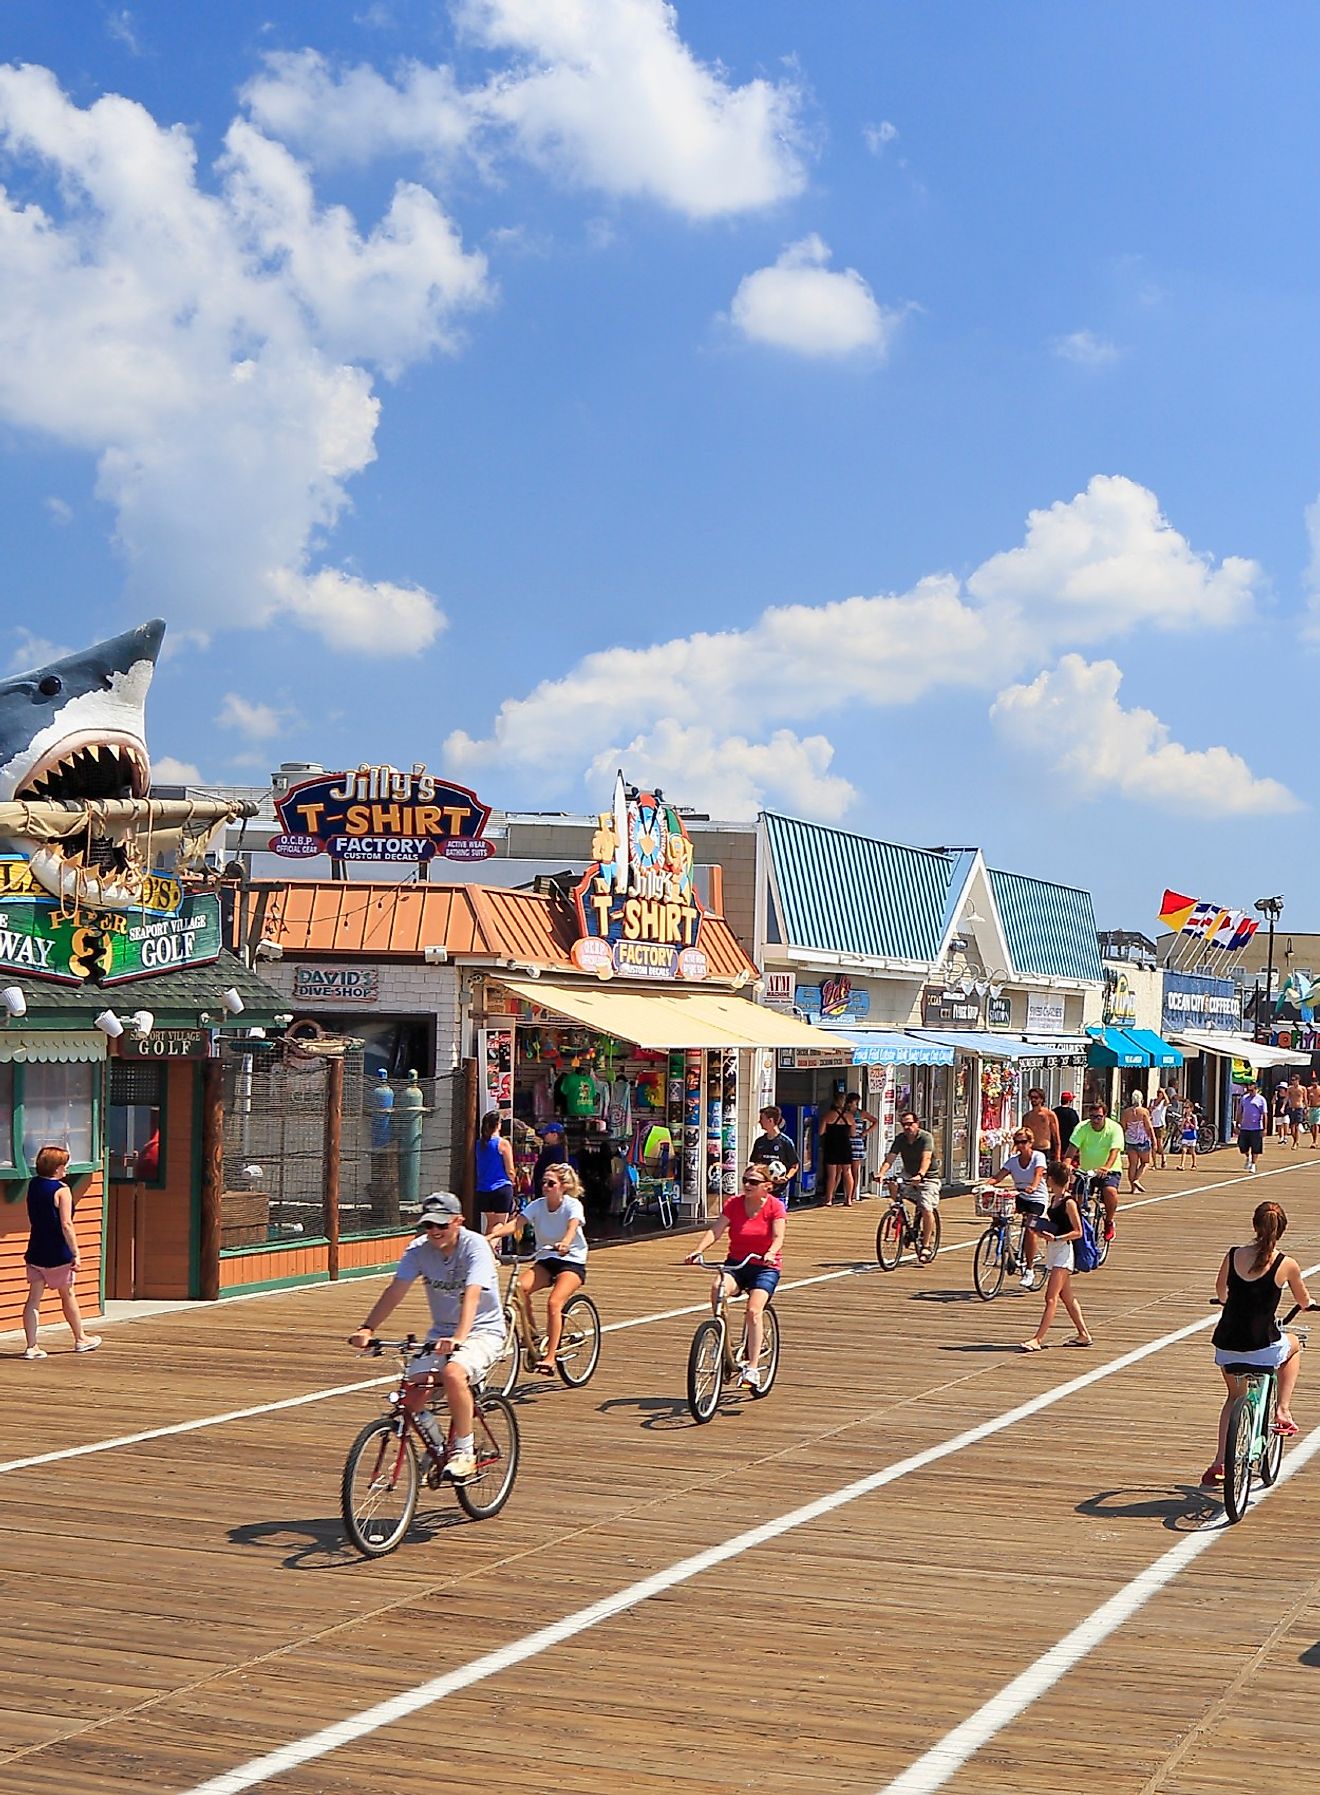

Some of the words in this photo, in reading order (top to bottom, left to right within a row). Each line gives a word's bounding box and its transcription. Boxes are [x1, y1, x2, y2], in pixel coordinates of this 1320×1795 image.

[329, 763, 436, 802] Jilly's
[296, 803, 471, 836] T-SHIRT
[335, 837, 428, 854] FACTORY
[344, 852, 382, 861] CUSTOM
[385, 853, 419, 861] DECALS
[129, 920, 168, 941] SEAPORT
[171, 914, 207, 934] VILLAGE
[591, 895, 698, 946] T-SHIRT
[141, 931, 197, 968] GOLF
[619, 943, 674, 967] FACTORY
[298, 969, 373, 986] DAVID'S
[769, 975, 790, 992] ATM
[299, 985, 331, 996] DIVE
[1167, 991, 1191, 1012] OCEAN
[1209, 996, 1231, 1014] COFFEE
[168, 1031, 201, 1041] VILLAGE
[138, 1040, 192, 1056] GOLF
